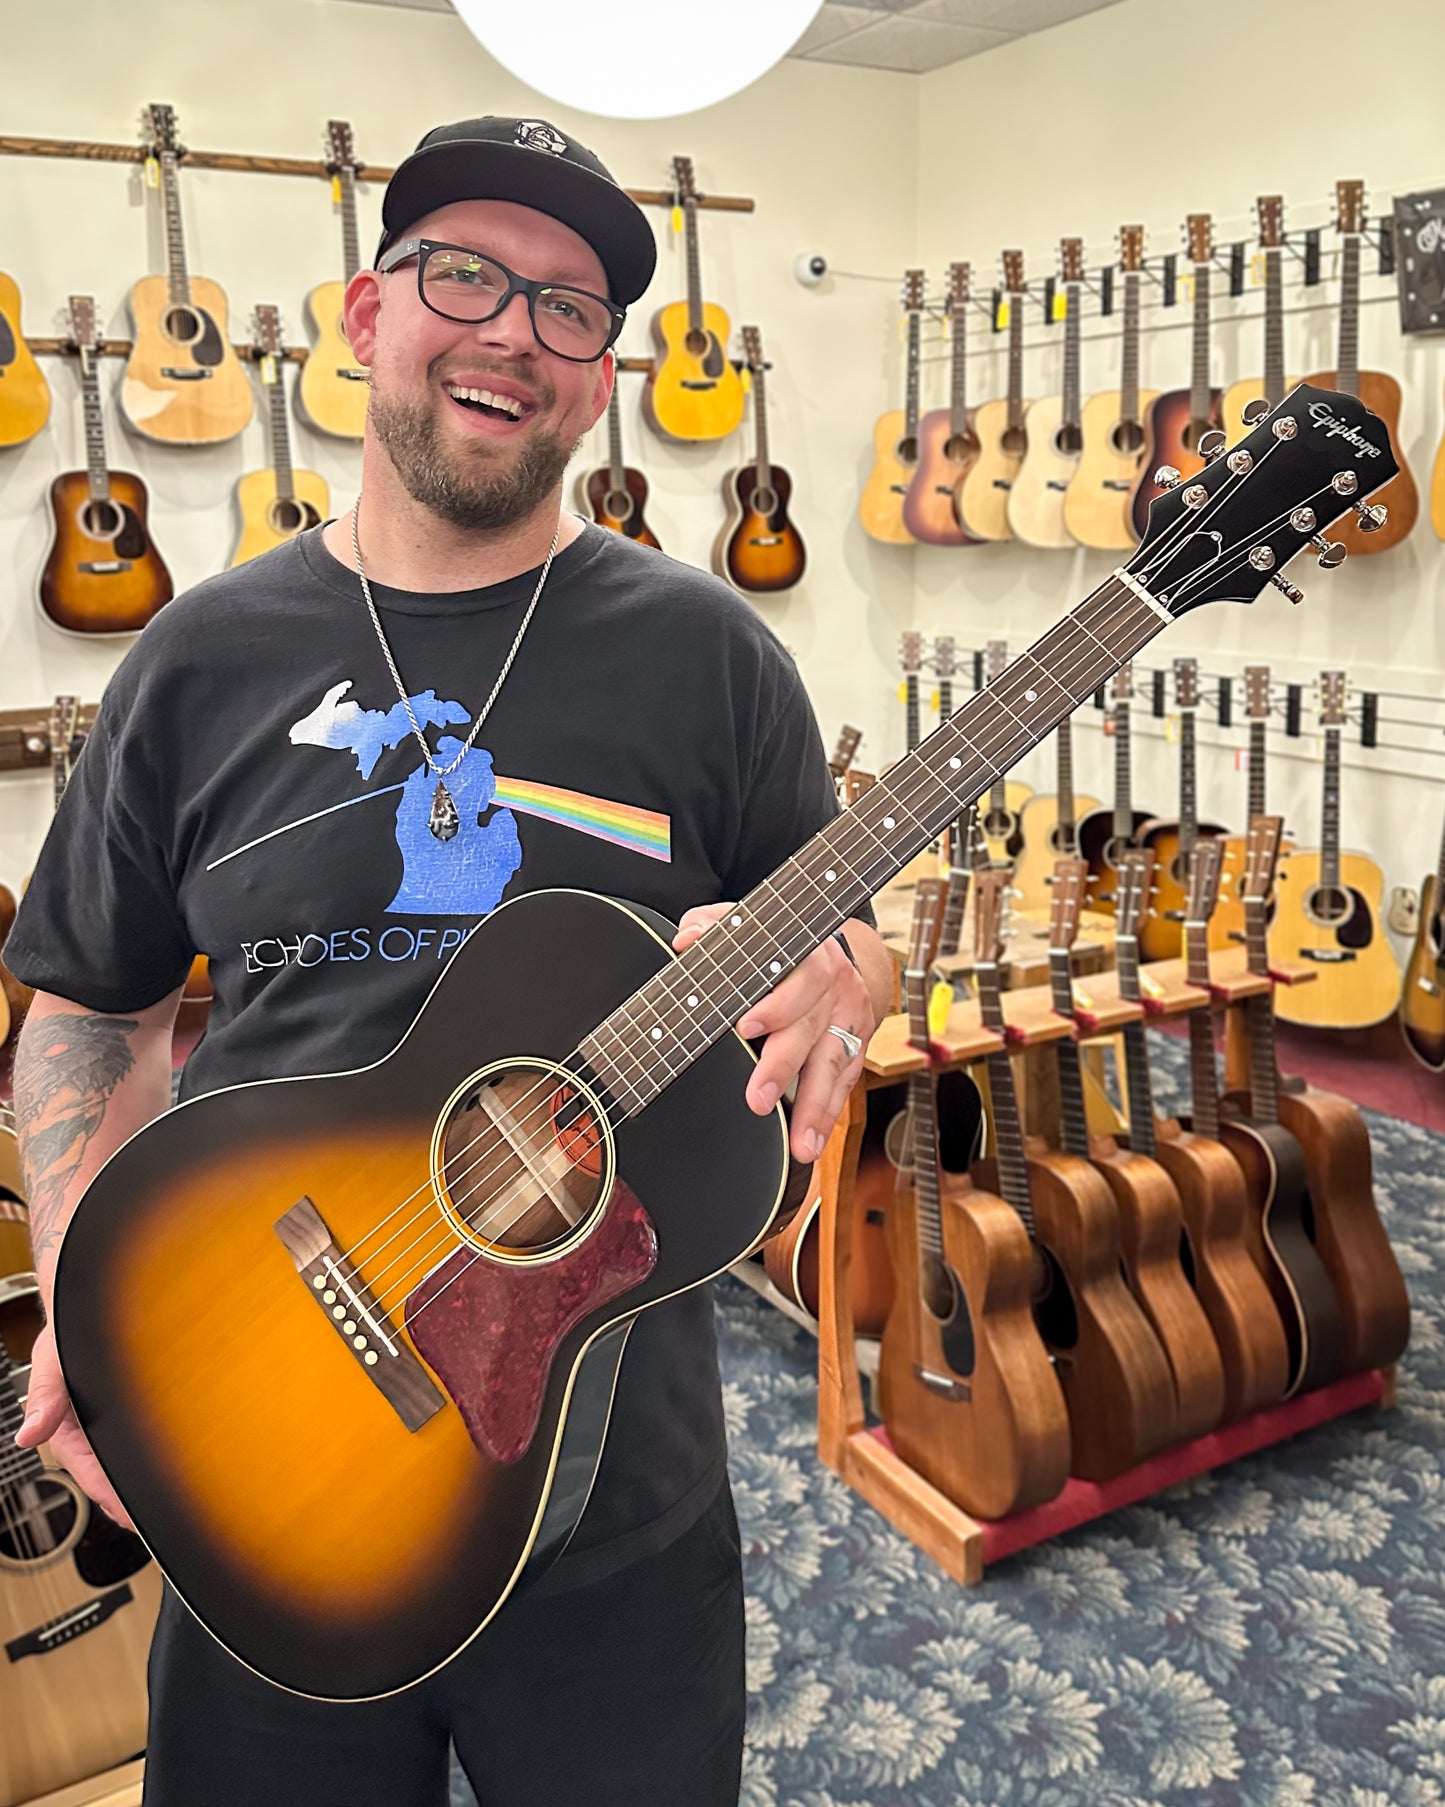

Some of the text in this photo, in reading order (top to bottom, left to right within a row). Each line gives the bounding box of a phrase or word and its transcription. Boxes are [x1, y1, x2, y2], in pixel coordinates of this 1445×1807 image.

[1307, 402, 1382, 459] Epiphone
[240, 927, 371, 974] ECHOES
[378, 926, 437, 962] OF
